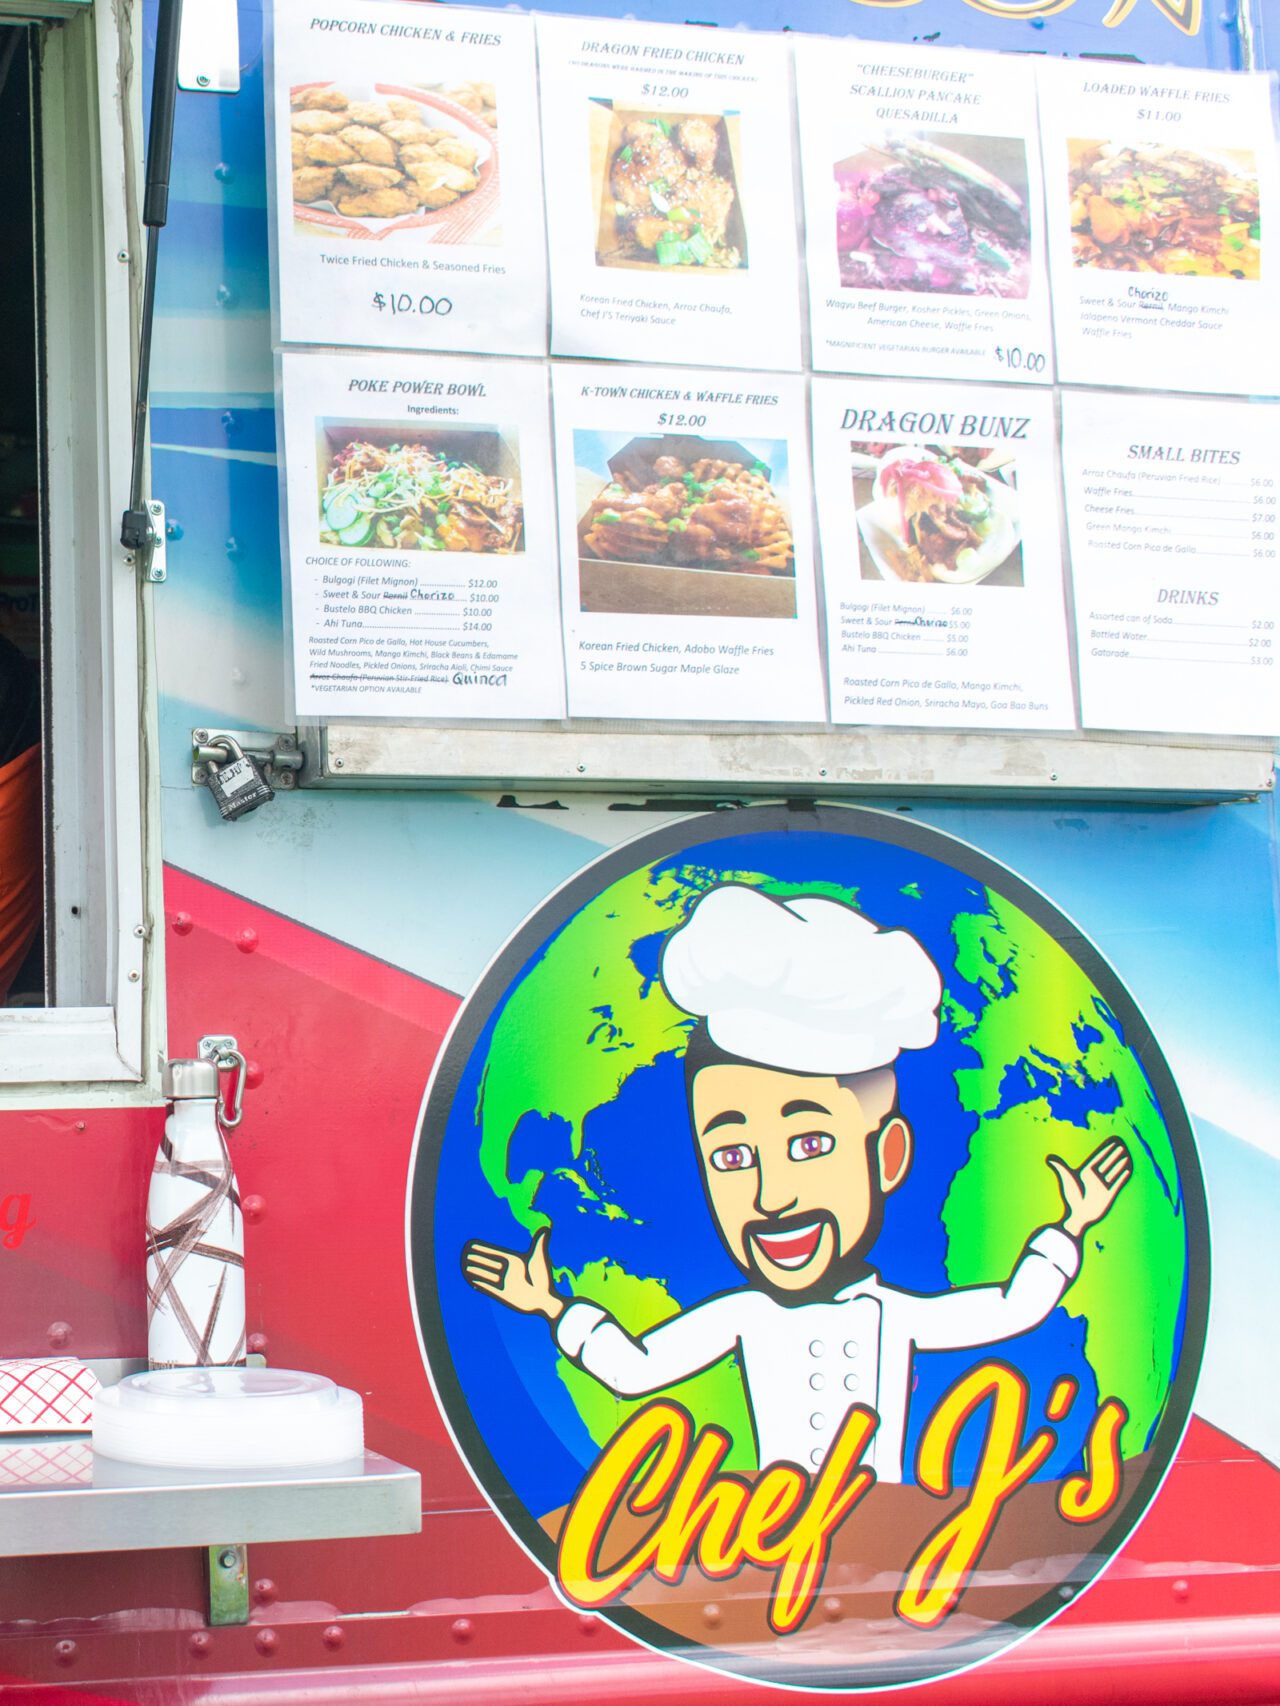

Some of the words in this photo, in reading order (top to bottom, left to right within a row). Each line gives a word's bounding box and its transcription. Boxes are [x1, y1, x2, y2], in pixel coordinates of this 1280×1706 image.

[310, 18, 377, 34] POPCORN
[380, 24, 442, 40] CHICKEN
[445, 31, 455, 41] &
[461, 32, 502, 46] FRIES
[581, 41, 640, 56] DRAGON
[643, 46, 682, 59] FRIED
[686, 49, 745, 65] CHICKEN
[856, 64, 975, 84] "CHEESEBURGER"
[641, 83, 689, 98] $12.00
[850, 84, 915, 99] SCALLION
[918, 90, 982, 105] PANCAKE
[1083, 82, 1136, 96] LOADED
[1140, 85, 1190, 100] WAFFLE
[1194, 90, 1231, 103] FRIES
[876, 107, 959, 123] QUESADILLA
[1137, 108, 1182, 122] $11.00
[320, 254, 349, 264] Twice
[352, 256, 377, 266] Fried
[380, 257, 419, 269] Chicken
[422, 260, 430, 269] &
[433, 260, 480, 273] Seasoned
[483, 264, 506, 274] Fries
[371, 291, 452, 316] $10.00
[994, 345, 1046, 373] $10.00
[348, 379, 390, 392] POKE
[392, 380, 444, 395] POWER
[446, 383, 486, 397] BOWL
[580, 386, 627, 398] K-TOWN
[629, 388, 680, 400] CHICKEN
[683, 391, 691, 401] &
[696, 390, 743, 404] WAFFLE
[745, 393, 779, 406] FRIES
[407, 404, 460, 415] Ingredients:
[657, 412, 706, 427] $12.00
[840, 408, 955, 435] DRAGON
[958, 414, 1032, 439] BUNZ
[1127, 444, 1185, 463] SMALL
[1190, 448, 1241, 466] BITES
[305, 556, 338, 566] CHOICE
[340, 557, 353, 567] OF
[354, 558, 412, 568] FOLLOWING:
[322, 575, 355, 586] Bulgogi
[358, 576, 380, 587] (Filet
[381, 577, 418, 588] Mignon)
[468, 579, 498, 589] $12.00
[323, 589, 349, 599] Sweet
[351, 590, 359, 599] &
[362, 591, 381, 600] Sour
[470, 593, 499, 603] $10.00
[1157, 588, 1220, 606] DRINKS
[323, 604, 356, 614] Bustelo
[358, 605, 377, 615] BBQ
[379, 605, 412, 615] Chicken
[463, 608, 492, 618] $10.00
[323, 619, 339, 628] Ahi
[341, 620, 363, 629] Tuna
[463, 622, 492, 631] $14.00
[579, 641, 613, 651] Korean
[616, 642, 640, 652] Fried
[642, 642, 682, 654] Chicken,
[684, 644, 716, 654] Adobo
[718, 645, 750, 656] Waffle
[752, 646, 774, 656] Fries
[580, 661, 586, 670] 5
[589, 661, 614, 672] Spice
[617, 662, 647, 672] Brown
[650, 663, 678, 675] Sugar
[680, 664, 711, 675] Maple
[713, 665, 740, 675] Glaze
[228, 791, 257, 811] Master
[558, 1403, 879, 1634] Chef
[896, 1361, 1126, 1626] J's
